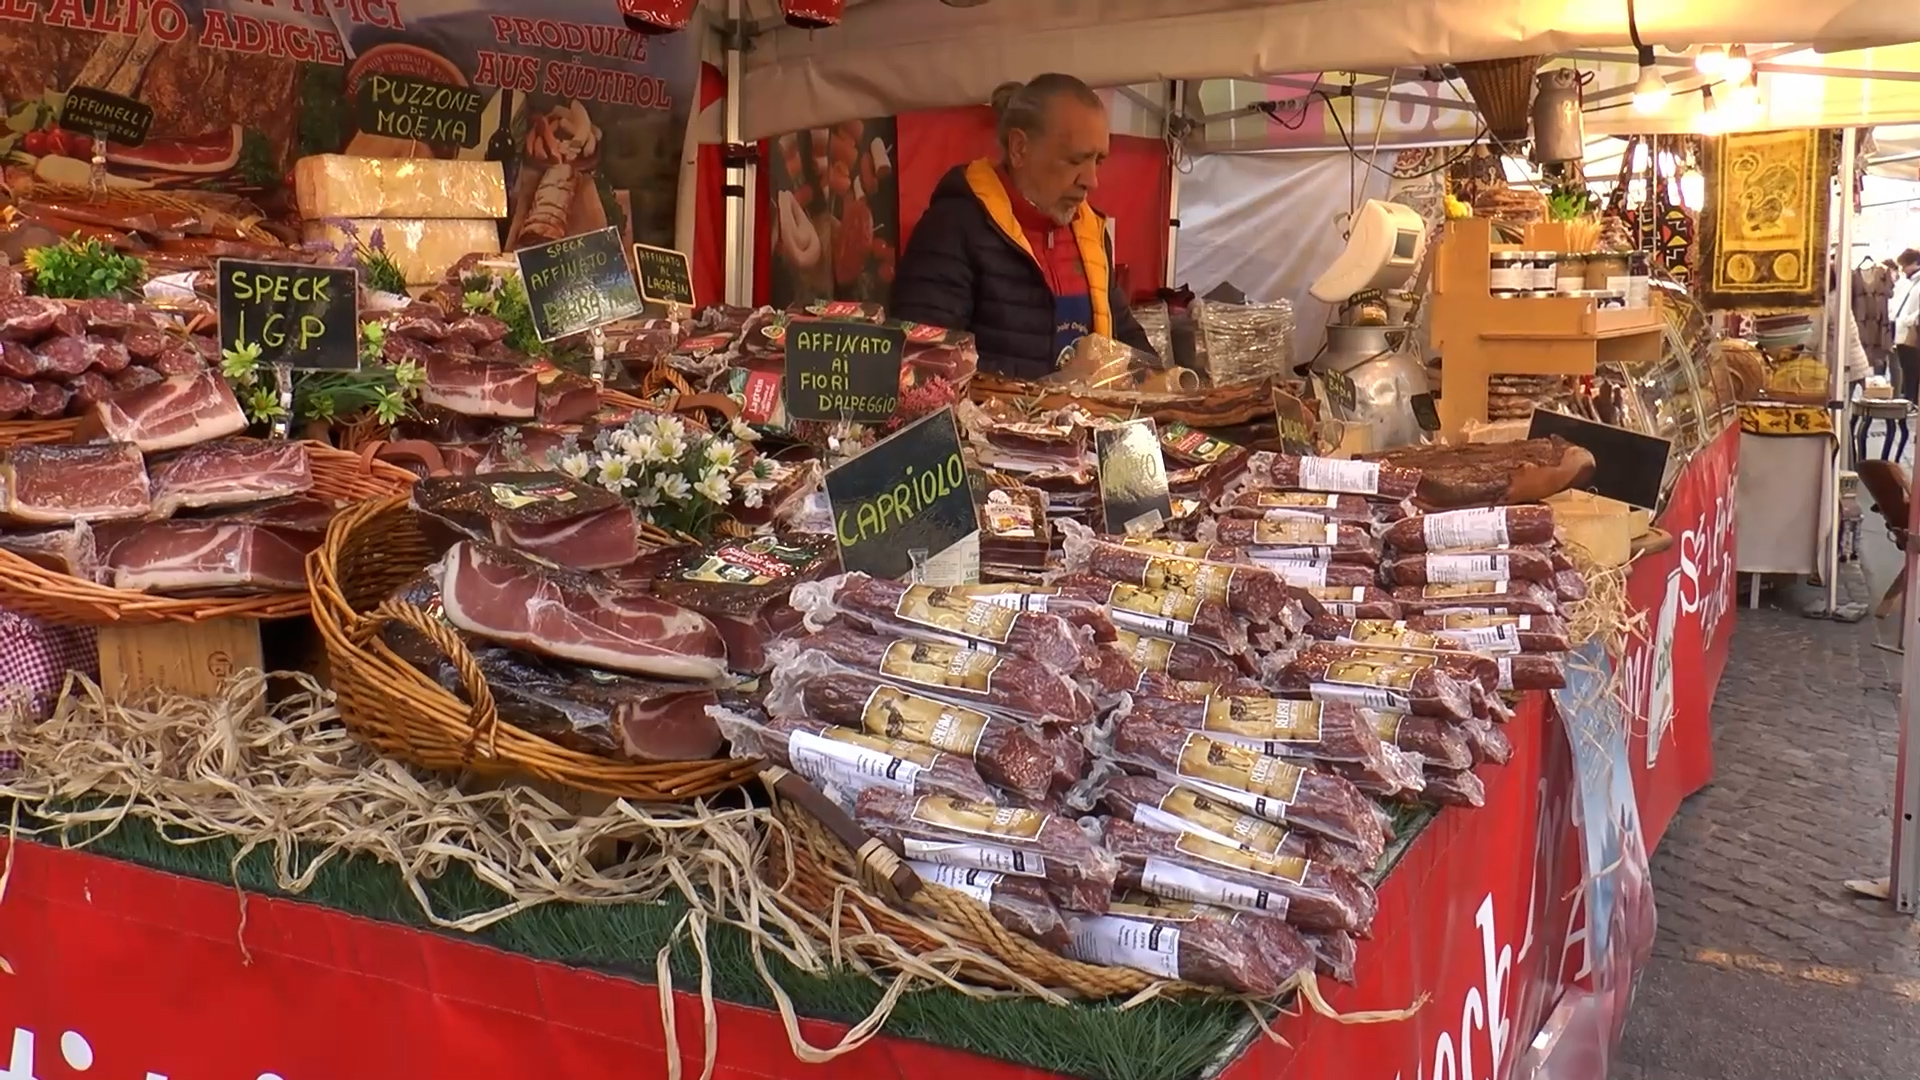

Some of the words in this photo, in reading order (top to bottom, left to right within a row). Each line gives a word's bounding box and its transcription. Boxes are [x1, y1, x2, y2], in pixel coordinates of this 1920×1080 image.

[200, 8, 345, 66] ADIGE
[491, 14, 649, 62] PRODUKTE
[369, 75, 480, 113] PUZZONE
[474, 50, 540, 92] AUS
[544, 55, 671, 110] SÜDTIROL
[377, 110, 466, 143] MOENA
[547, 237, 586, 259] SPECK
[640, 250, 681, 268] AFFINATO
[231, 270, 331, 305] SPECK
[530, 251, 608, 291] AFFINATO
[647, 275, 688, 295] LAGREIN
[798, 331, 892, 354] AFFINATO
[831, 354, 849, 373] AI
[749, 378, 764, 414] Lagrein
[801, 373, 849, 391] FIORI
[819, 393, 896, 414] D'ALPEGGIO
[837, 453, 965, 548] CAPRIOLO
